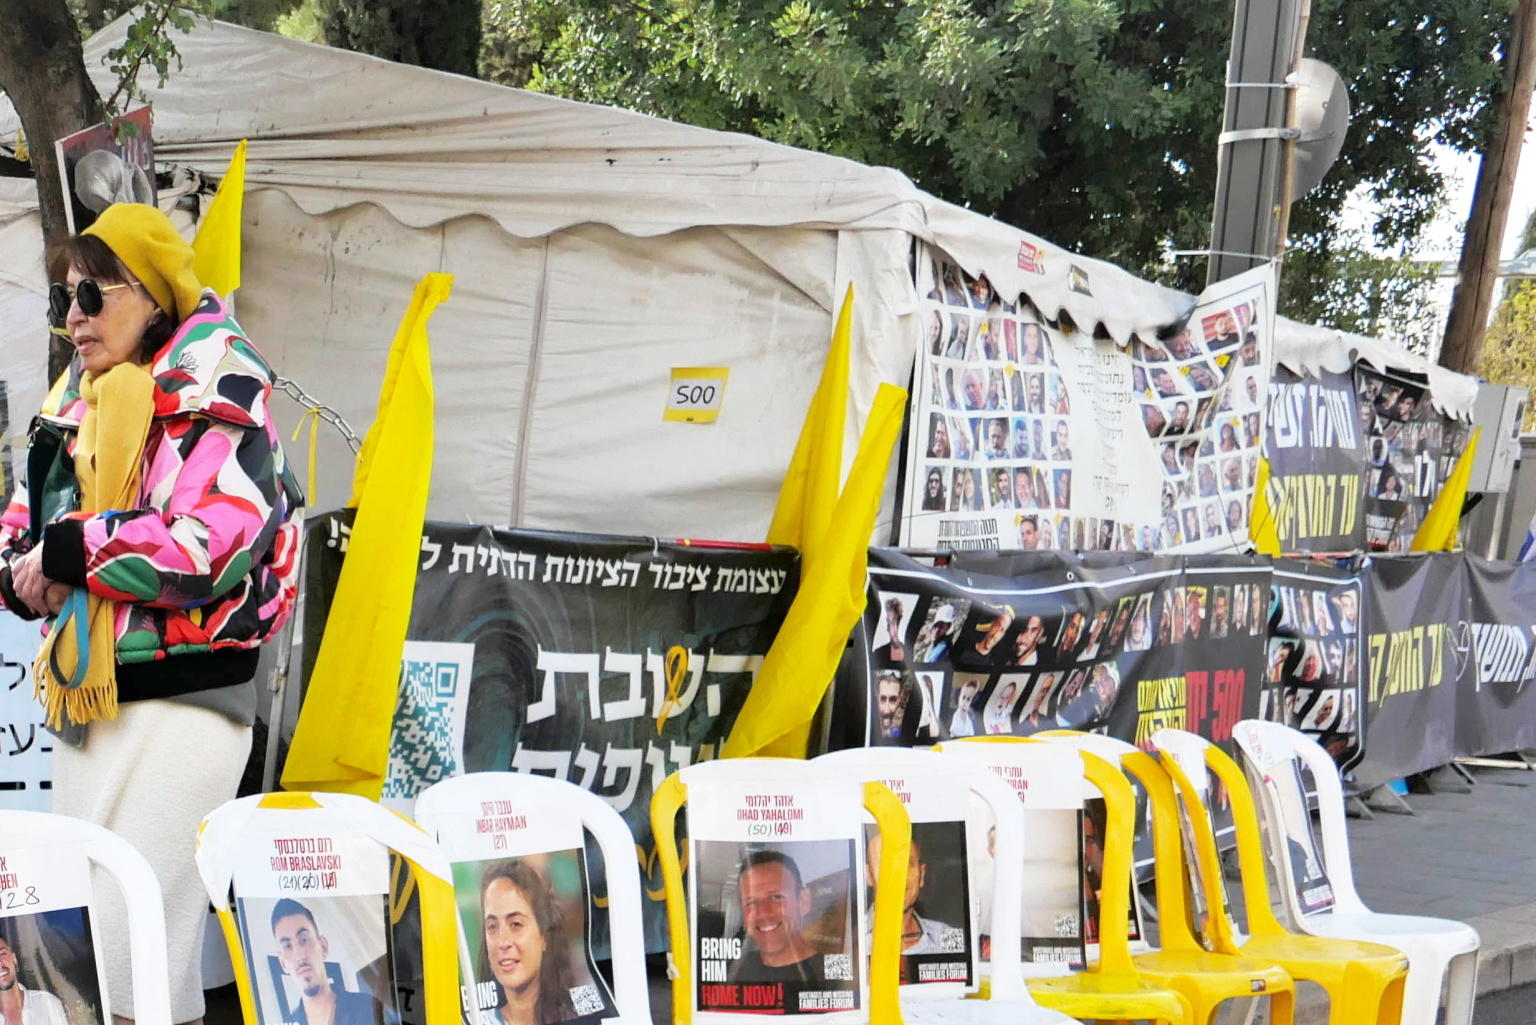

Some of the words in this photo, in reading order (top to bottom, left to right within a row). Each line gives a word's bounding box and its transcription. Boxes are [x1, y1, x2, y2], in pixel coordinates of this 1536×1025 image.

[448, 542, 537, 581] הדתית
[542, 553, 641, 587] הציונות
[648, 560, 711, 592] ציבור
[713, 565, 786, 594] עצומת
[526, 643, 764, 724] השבת
[745, 795, 771, 807] יהלומי
[774, 795, 794, 807] אוהד
[494, 816, 527, 832] HAYMAN
[737, 809, 759, 821] OHAD
[761, 808, 803, 821] YAHALOMI
[318, 838, 332, 853] רום
[270, 856, 288, 871] ROM
[289, 855, 341, 871] BRASLAVSKI
[701, 937, 741, 960] BRING
[701, 960, 727, 982] HIM
[919, 970, 946, 981] FAMILIES
[702, 985, 739, 1006] HOME
[743, 982, 784, 1007] NOW!
[799, 998, 828, 1009] FAMILIES
[829, 997, 855, 1009] FORUM
